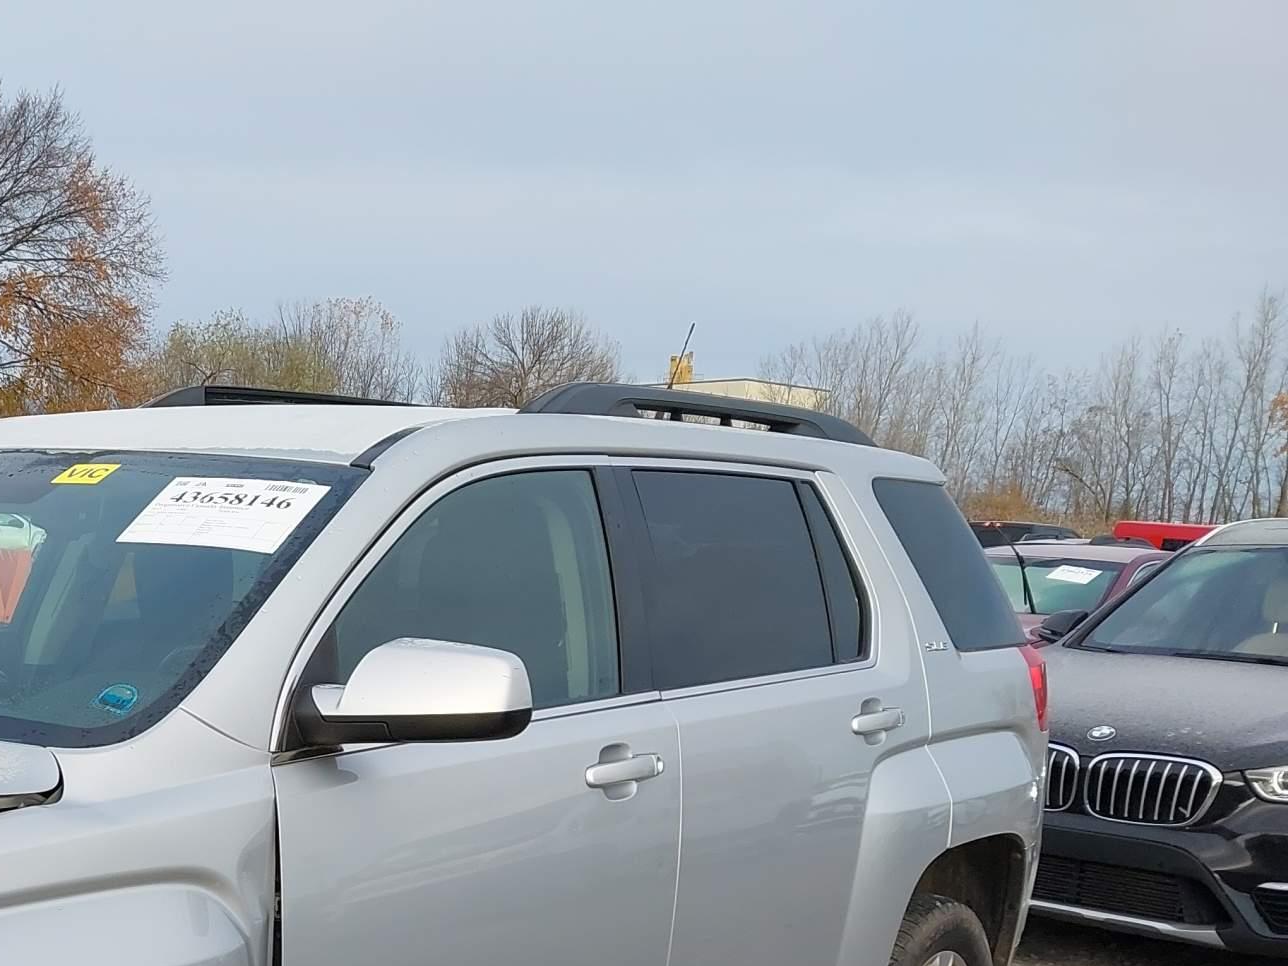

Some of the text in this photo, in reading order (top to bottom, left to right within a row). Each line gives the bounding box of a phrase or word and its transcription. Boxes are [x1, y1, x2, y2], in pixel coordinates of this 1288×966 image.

[66, 467, 110, 479] VIC
[170, 490, 296, 510] 43658146
[924, 640, 949, 652] SLE
